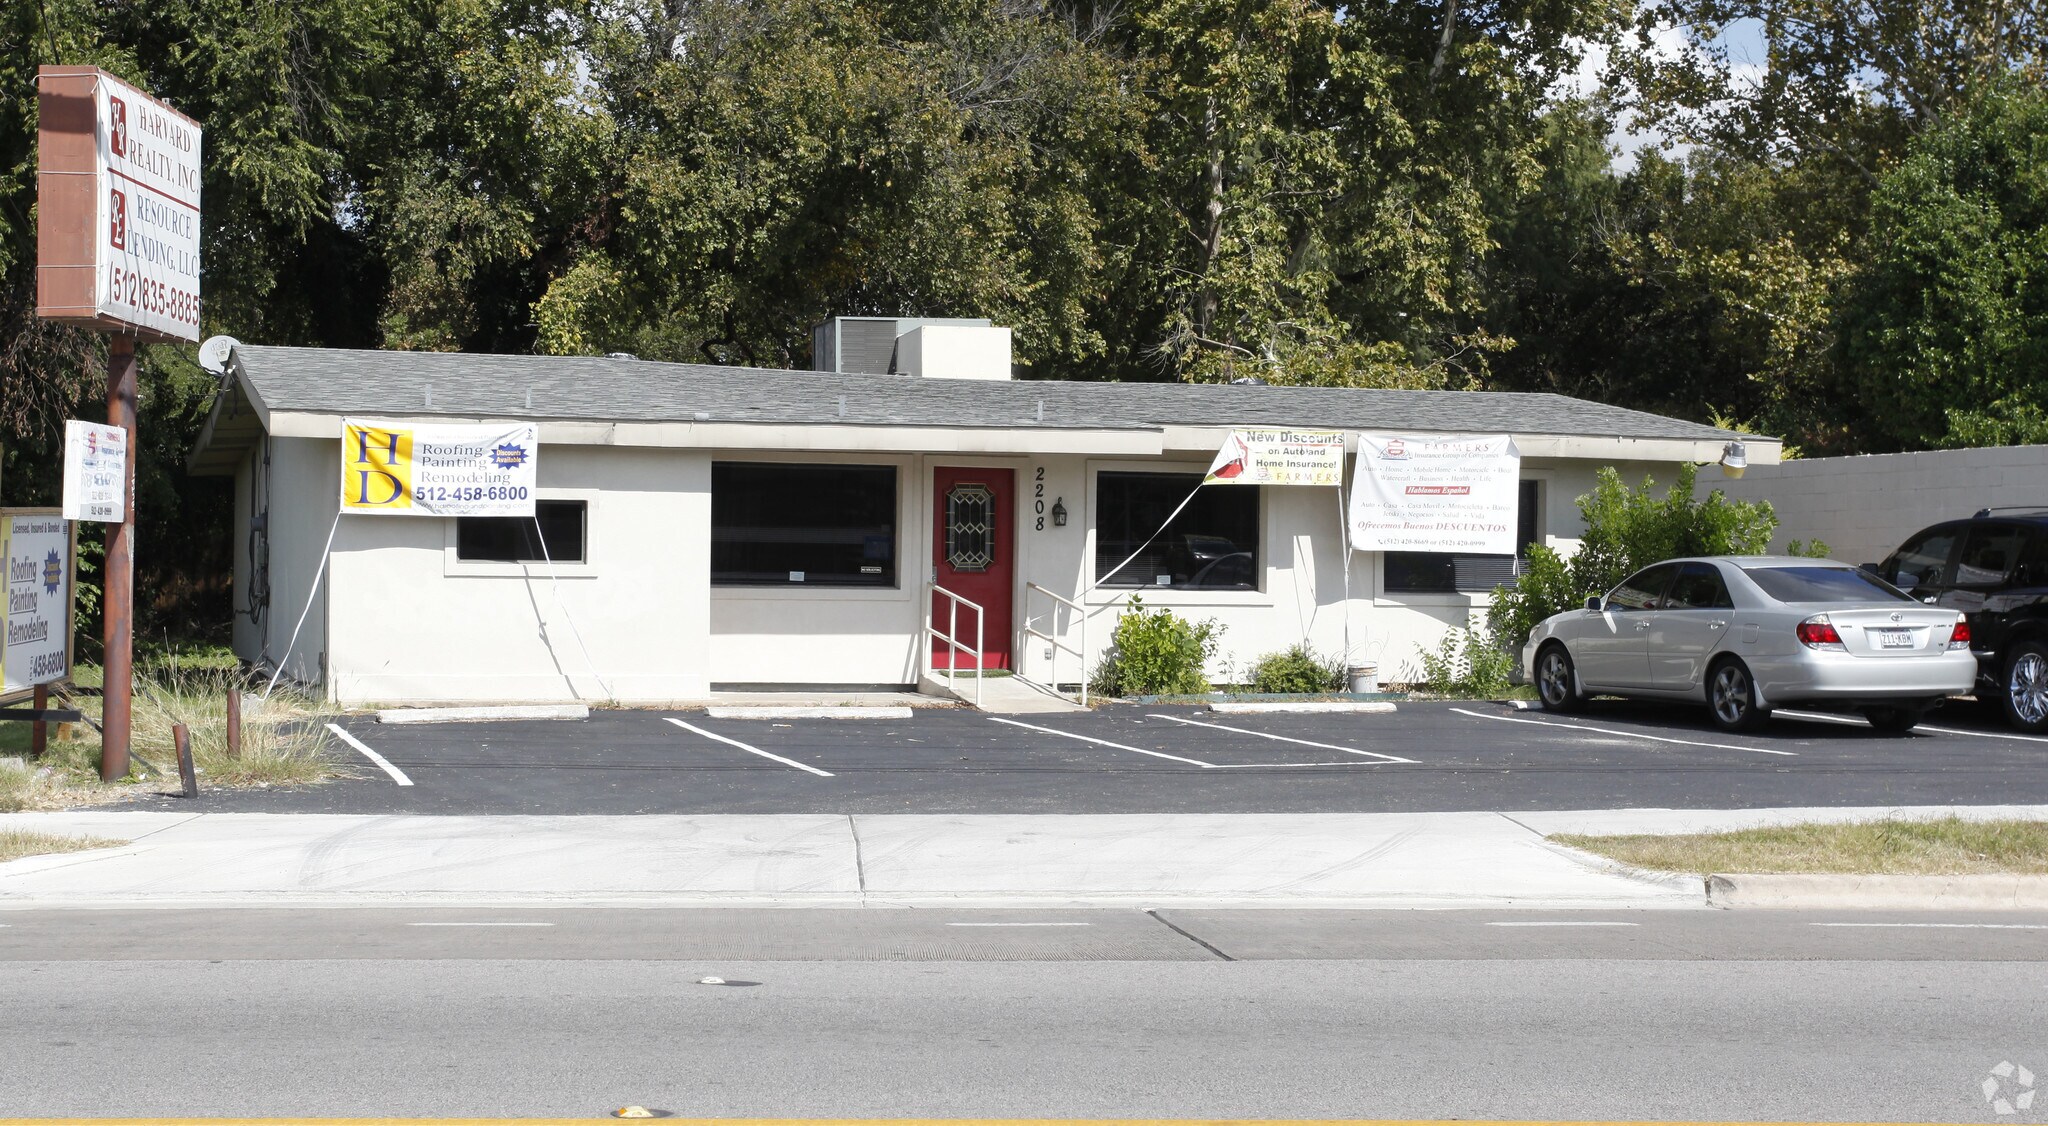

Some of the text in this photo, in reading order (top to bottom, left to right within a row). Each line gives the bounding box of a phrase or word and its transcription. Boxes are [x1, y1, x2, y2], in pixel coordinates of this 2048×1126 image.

[138, 105, 191, 153] HARVARD
[129, 139, 200, 194] REALTY, INC.
[137, 194, 192, 240] RESOURCE
[127, 229, 176, 275] LENDING,
[109, 261, 199, 326] (512)835-8885
[354, 431, 403, 465] H
[1246, 431, 1344, 444] New Discounts
[1424, 443, 1489, 452] FARMERS
[422, 443, 483, 457] Roofing
[1468, 452, 1499, 460] Companies
[422, 457, 487, 471] Painting
[1256, 459, 1337, 468] Home Insurance!
[353, 470, 403, 504] D
[421, 471, 511, 486] Remodeling
[1276, 472, 1340, 482] FARMERS
[416, 486, 528, 501] 512-458-6800
[1035, 467, 1045, 531] 2208
[1408, 486, 1469, 495] Hablamos Español
[1408, 511, 1434, 519] Negocios
[1358, 521, 1508, 532] Ofrecemos Buenos DESCUENTOS
[11, 556, 37, 583] Roofing
[9, 586, 38, 613] Painting
[8, 615, 48, 642] Remodeling
[33, 651, 64, 678] 458-6800
